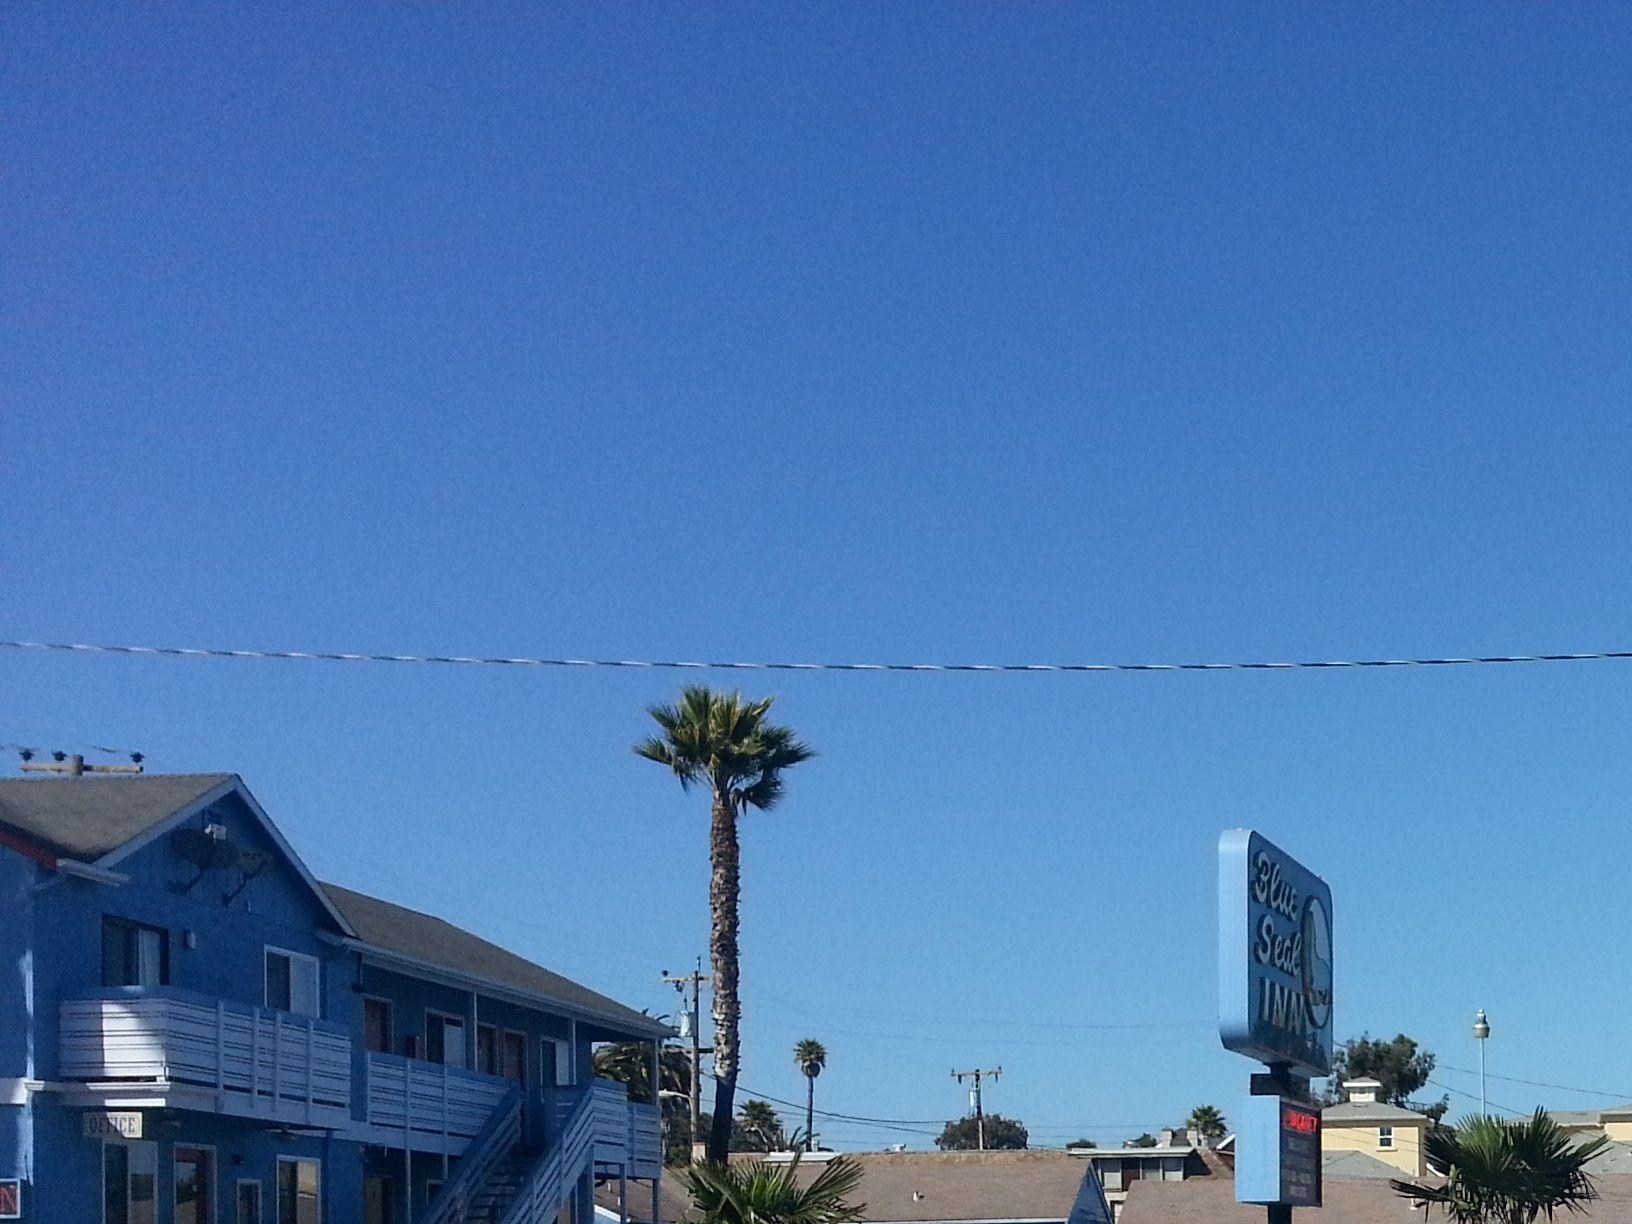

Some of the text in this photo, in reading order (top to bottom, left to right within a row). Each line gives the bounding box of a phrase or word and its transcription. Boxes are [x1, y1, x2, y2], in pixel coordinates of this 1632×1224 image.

[1254, 851, 1298, 920] Blue
[1256, 914, 1301, 975] Seal
[1261, 977, 1306, 1034] INN
[89, 1116, 136, 1133] OFFICE
